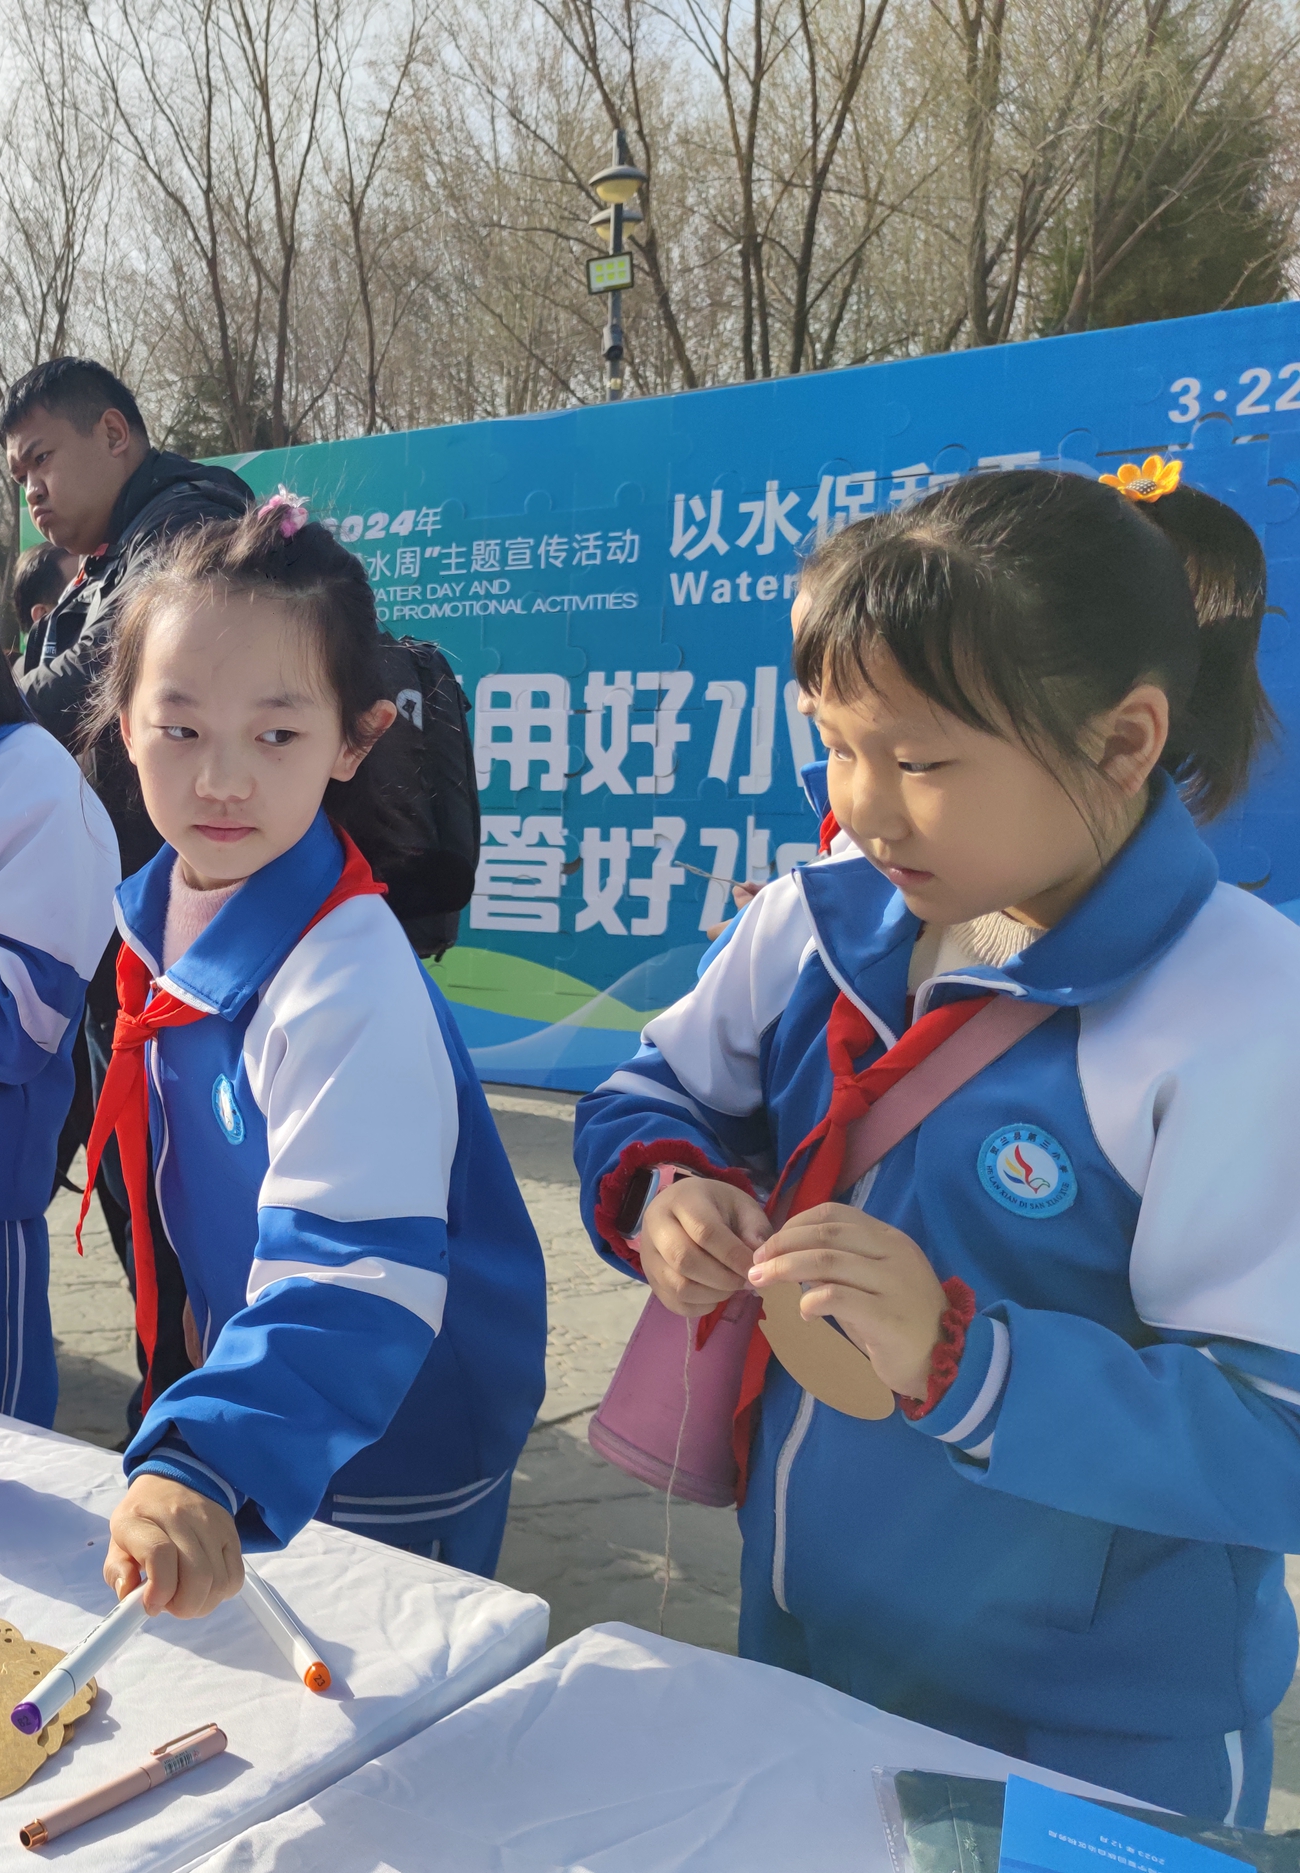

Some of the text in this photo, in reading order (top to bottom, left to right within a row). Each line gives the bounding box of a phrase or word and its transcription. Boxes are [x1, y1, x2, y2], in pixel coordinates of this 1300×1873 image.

[374, 578, 511, 603] ATER DAY AND
[393, 598, 527, 622] PROMOTIONAL
[532, 592, 638, 614] ACTIVITIES
[313, 1674, 326, 1687] 23
